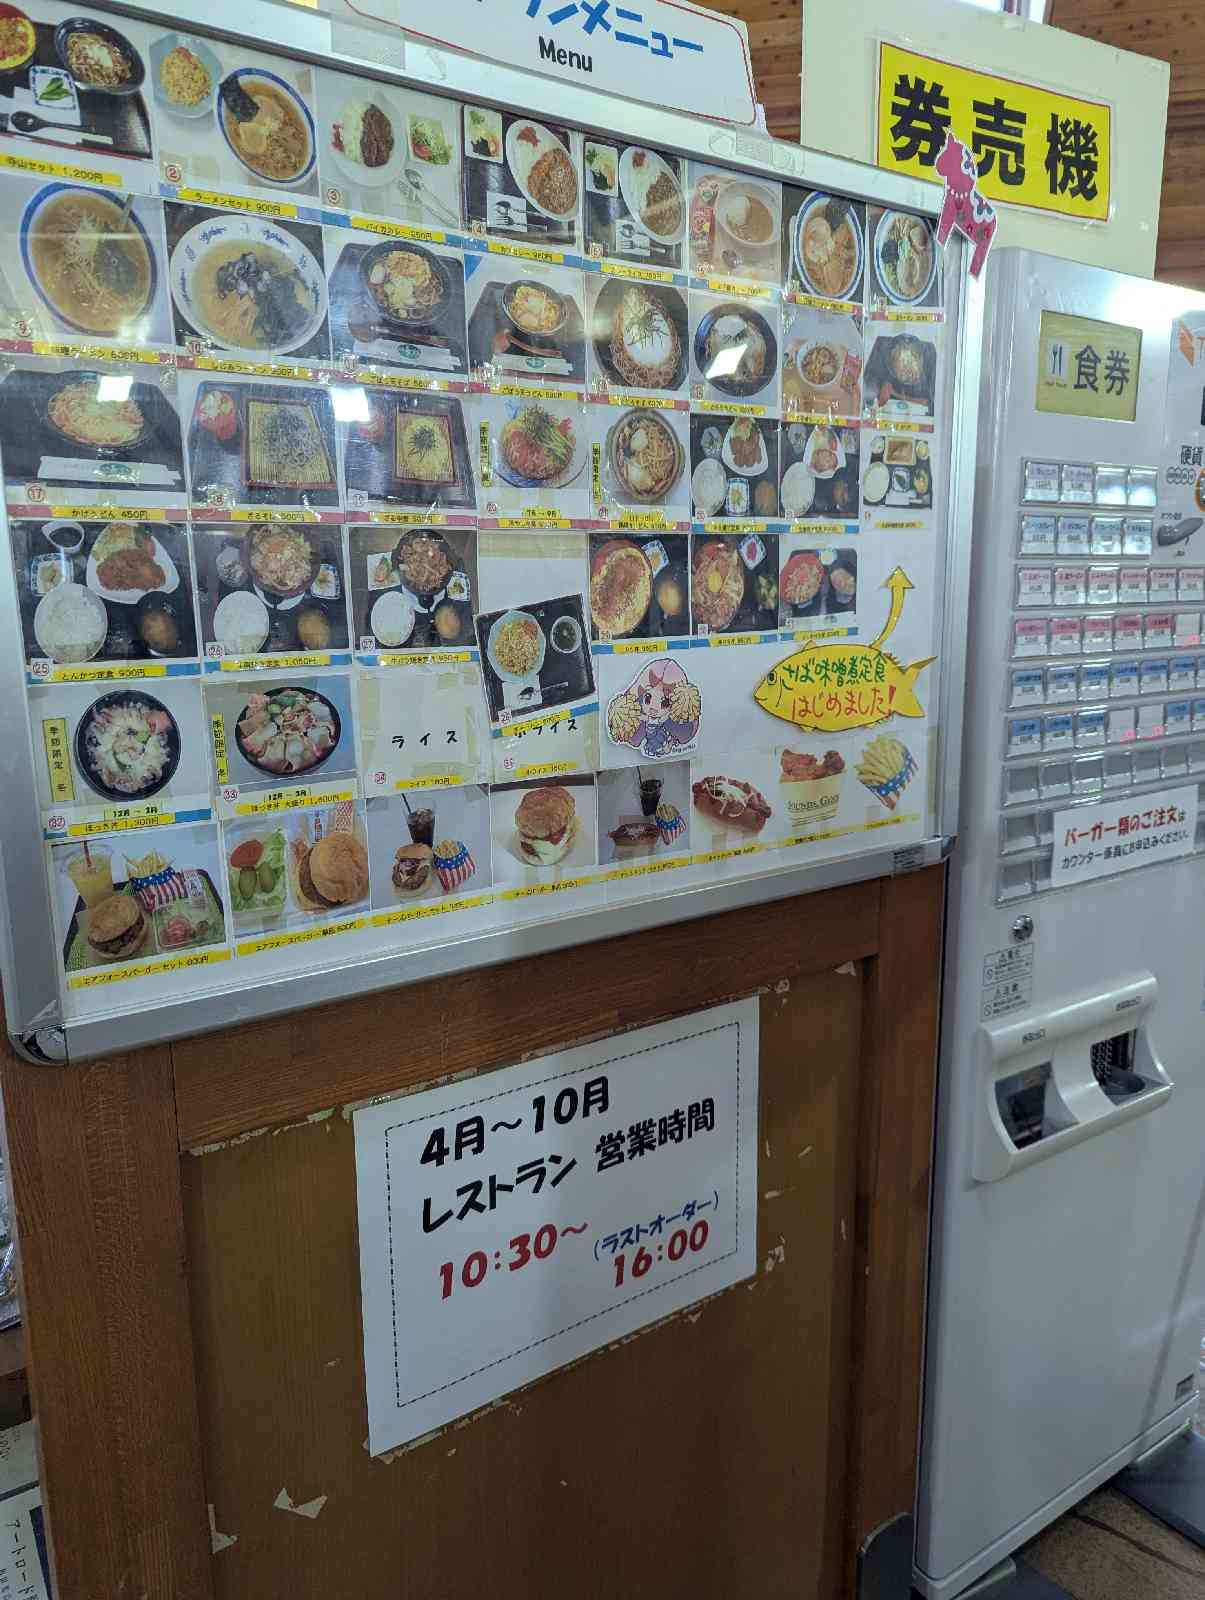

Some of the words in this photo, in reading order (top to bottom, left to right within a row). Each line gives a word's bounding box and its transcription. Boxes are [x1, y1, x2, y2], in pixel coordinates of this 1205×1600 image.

[538, 35, 593, 72] Menu
[890, 74, 1098, 201] 券売機
[195, 191, 251, 210] ラーメンセット
[1073, 344, 1130, 396] 食券
[1180, 445, 1203, 466] 硬貨
[71, 509, 116, 519] かけうどん
[62, 669, 114, 681] とんかつ定食
[782, 653, 886, 690] さば味噌煮定食
[391, 730, 458, 749] ライス
[419, 1075, 610, 1168] 4月～10月
[422, 1153, 578, 1234] レストラン
[594, 1097, 716, 1173] 営業時間
[594, 1191, 720, 1262] (ラストオーダー)
[440, 1222, 589, 1300] 10:30～
[612, 1219, 709, 1289] 16:00
